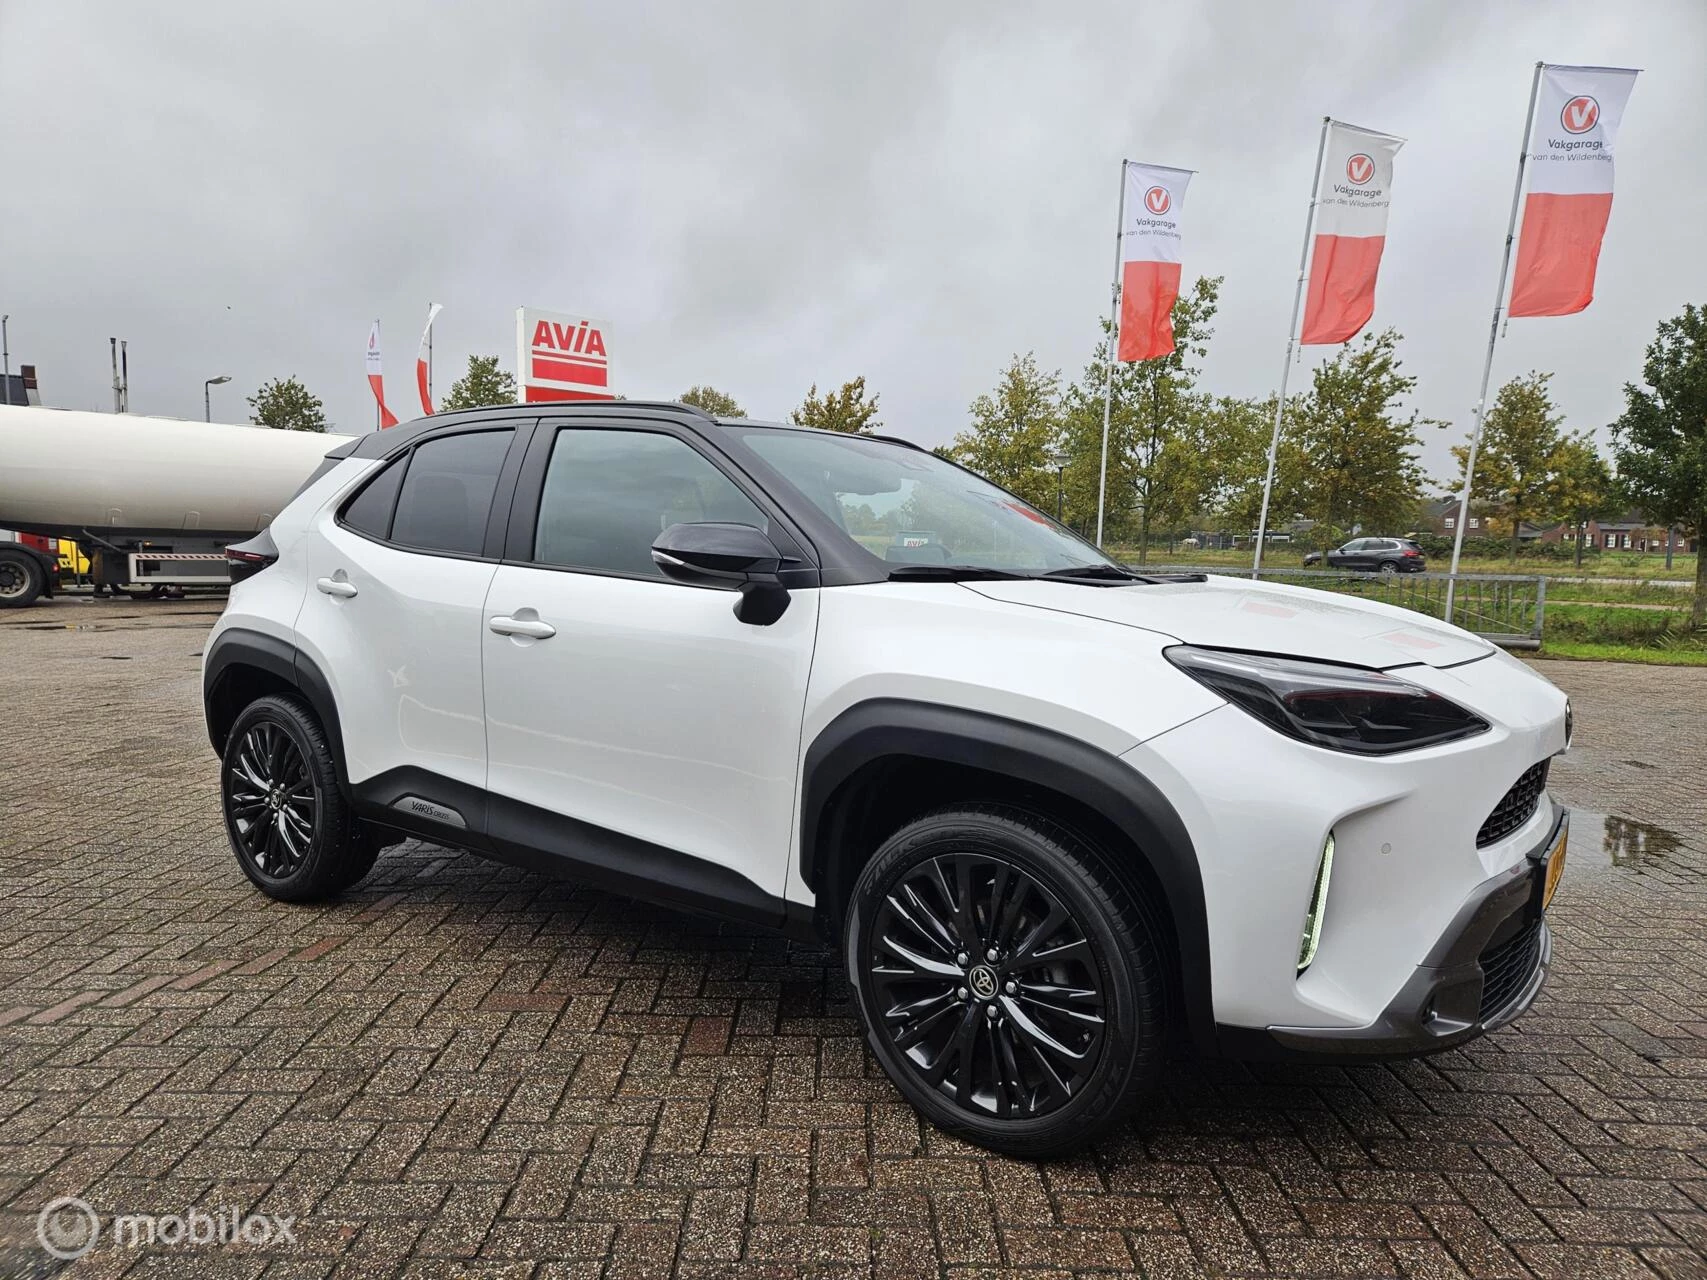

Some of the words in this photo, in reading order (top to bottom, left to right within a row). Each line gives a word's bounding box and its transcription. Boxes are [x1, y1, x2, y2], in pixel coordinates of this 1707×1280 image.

[1532, 153, 1548, 161] van
[1550, 152, 1565, 161] den
[1567, 152, 1613, 162] Wildenbeg
[1333, 184, 1382, 199] Vakgarage
[1136, 218, 1176, 229] Vakgarage
